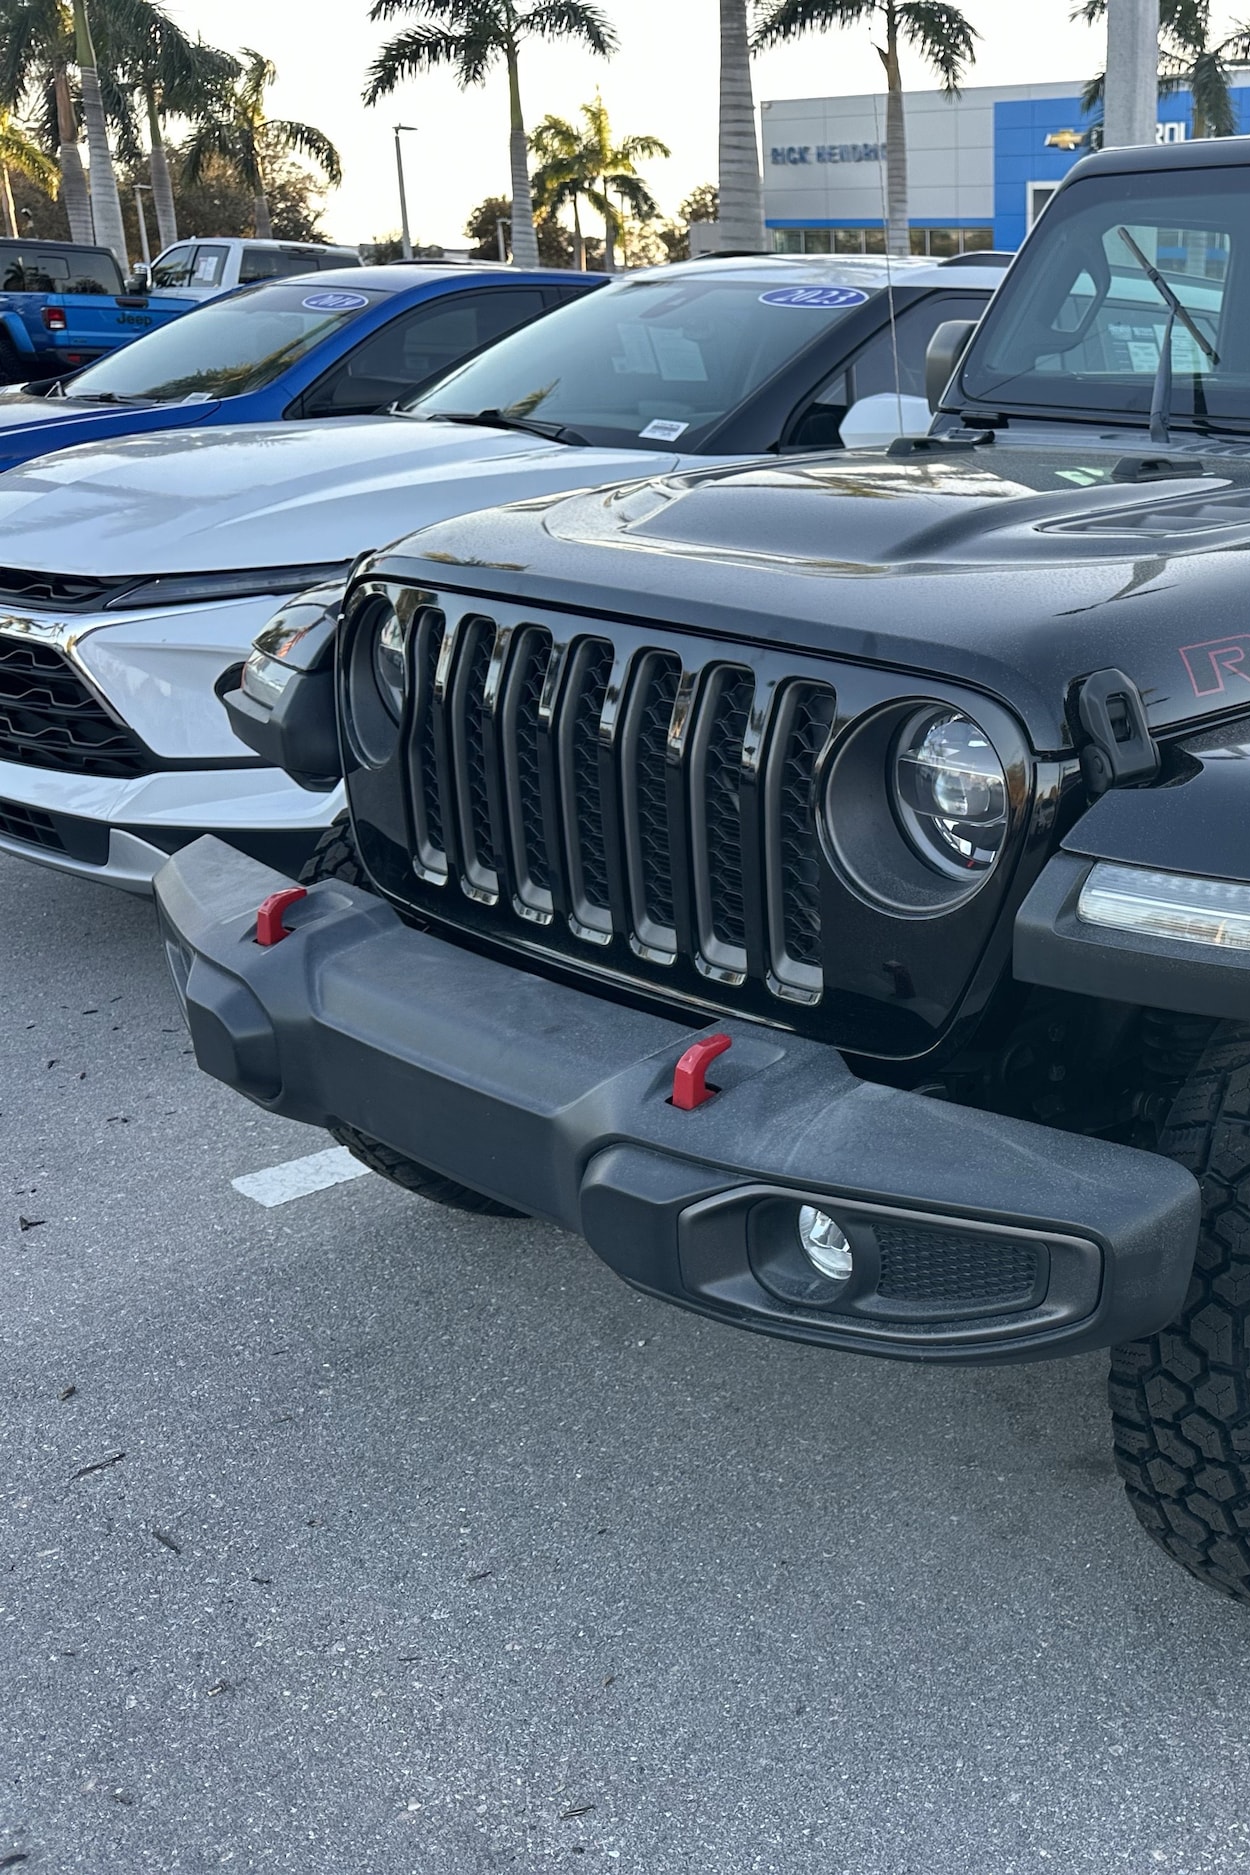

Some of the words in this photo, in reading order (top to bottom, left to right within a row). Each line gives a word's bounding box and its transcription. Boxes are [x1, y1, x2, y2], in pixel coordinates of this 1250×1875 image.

[770, 146, 810, 165] RICK
[772, 288, 857, 305] 2023
[116, 311, 153, 327] Jeep
